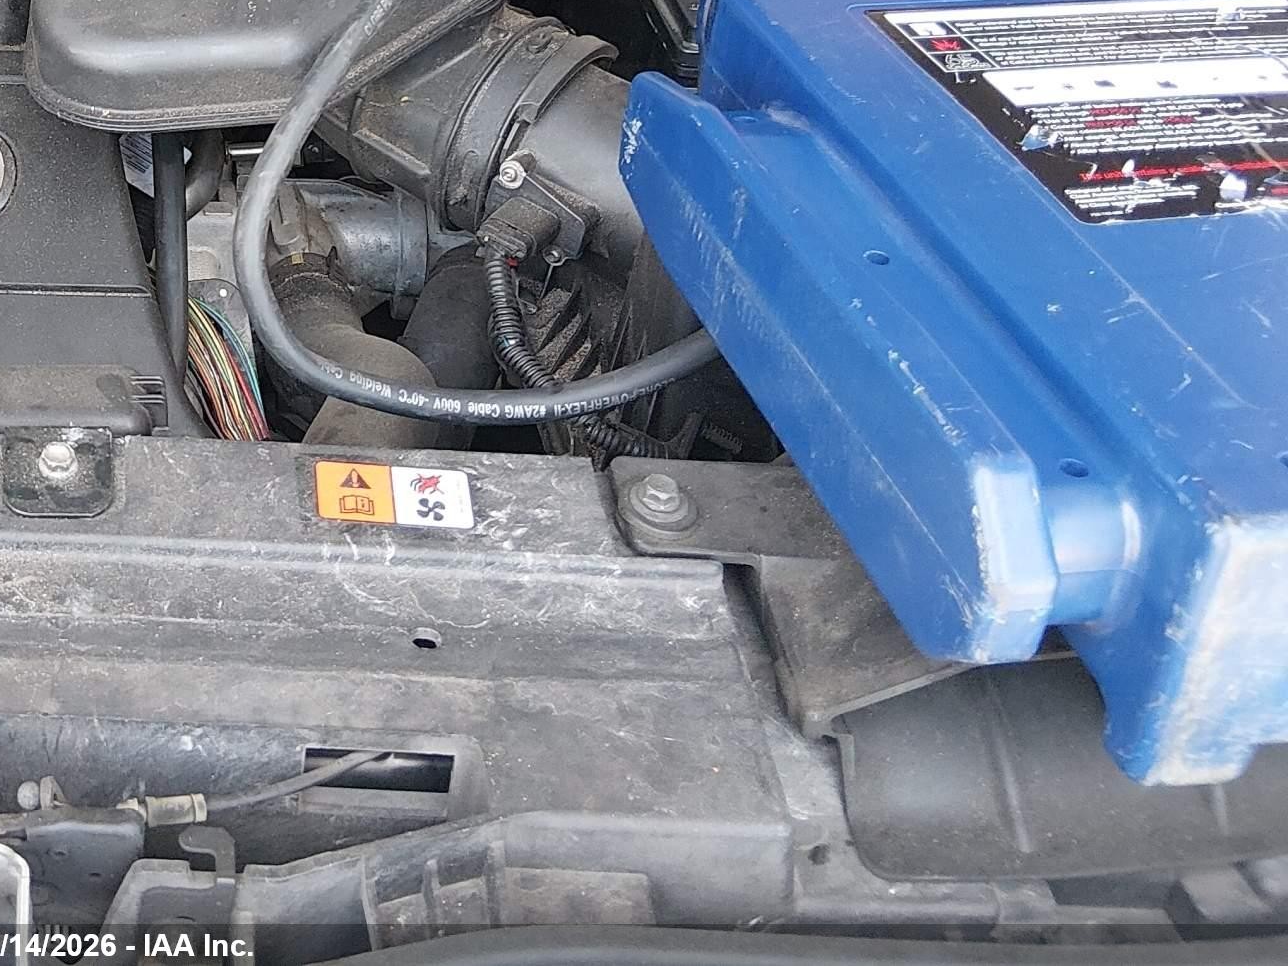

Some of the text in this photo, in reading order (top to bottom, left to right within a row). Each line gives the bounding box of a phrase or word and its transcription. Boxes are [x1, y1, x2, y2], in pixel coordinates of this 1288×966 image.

[349, 370, 392, 398] Welding
[433, 396, 461, 414] 600V
[468, 401, 500, 418] Cable
[504, 403, 546, 418] #2AWG
